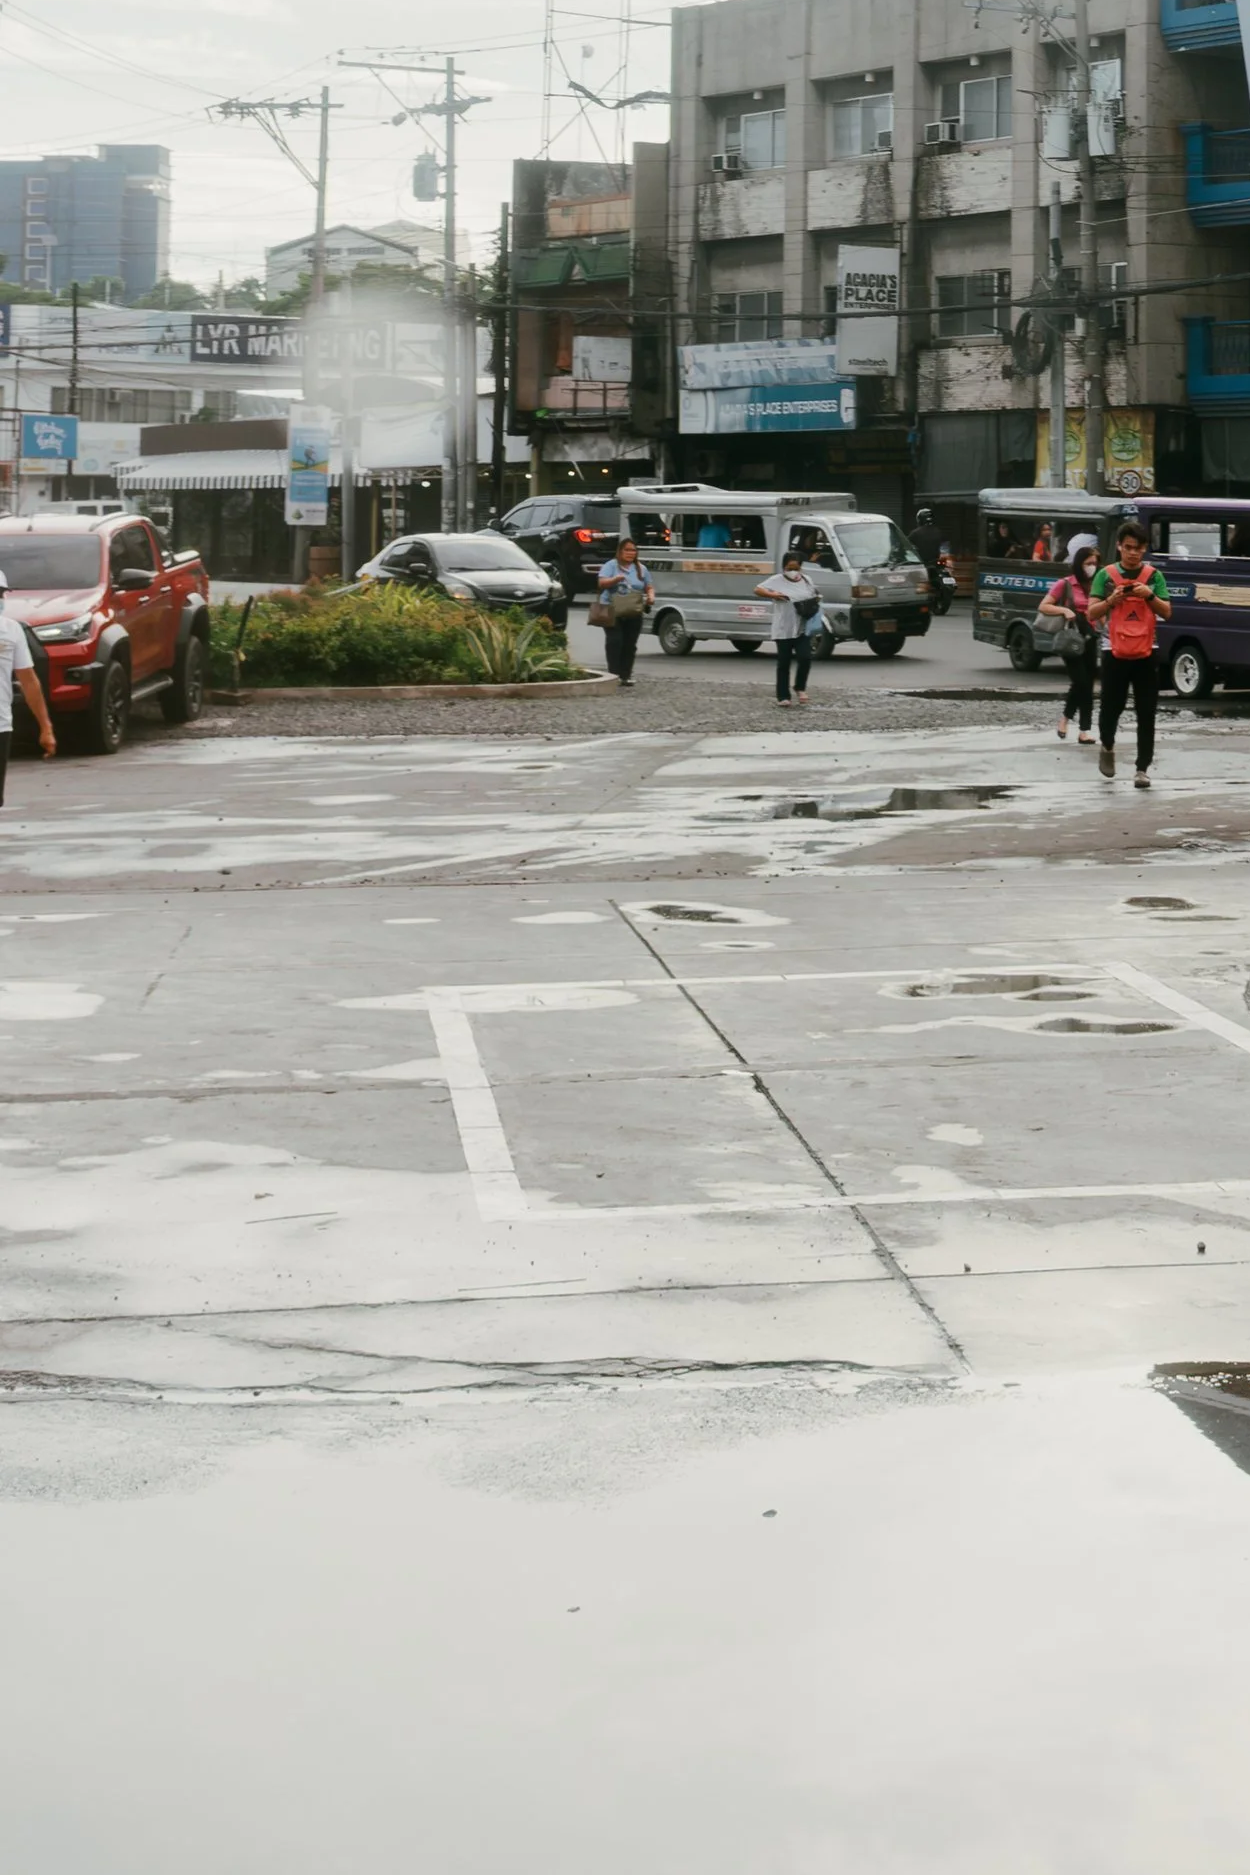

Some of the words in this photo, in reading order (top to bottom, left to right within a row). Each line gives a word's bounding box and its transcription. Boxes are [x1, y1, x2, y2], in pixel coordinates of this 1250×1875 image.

[845, 272, 897, 288] ACACIA'S
[845, 287, 897, 303] PLACE
[844, 302, 897, 311] ENTERPRISES
[195, 323, 241, 356] LYR
[247, 324, 382, 359] MARETNG
[756, 401, 782, 416] PLACE
[783, 399, 838, 414] ENTERPRISES
[1122, 476, 1138, 489] 30
[983, 574, 1022, 587] ROUTE
